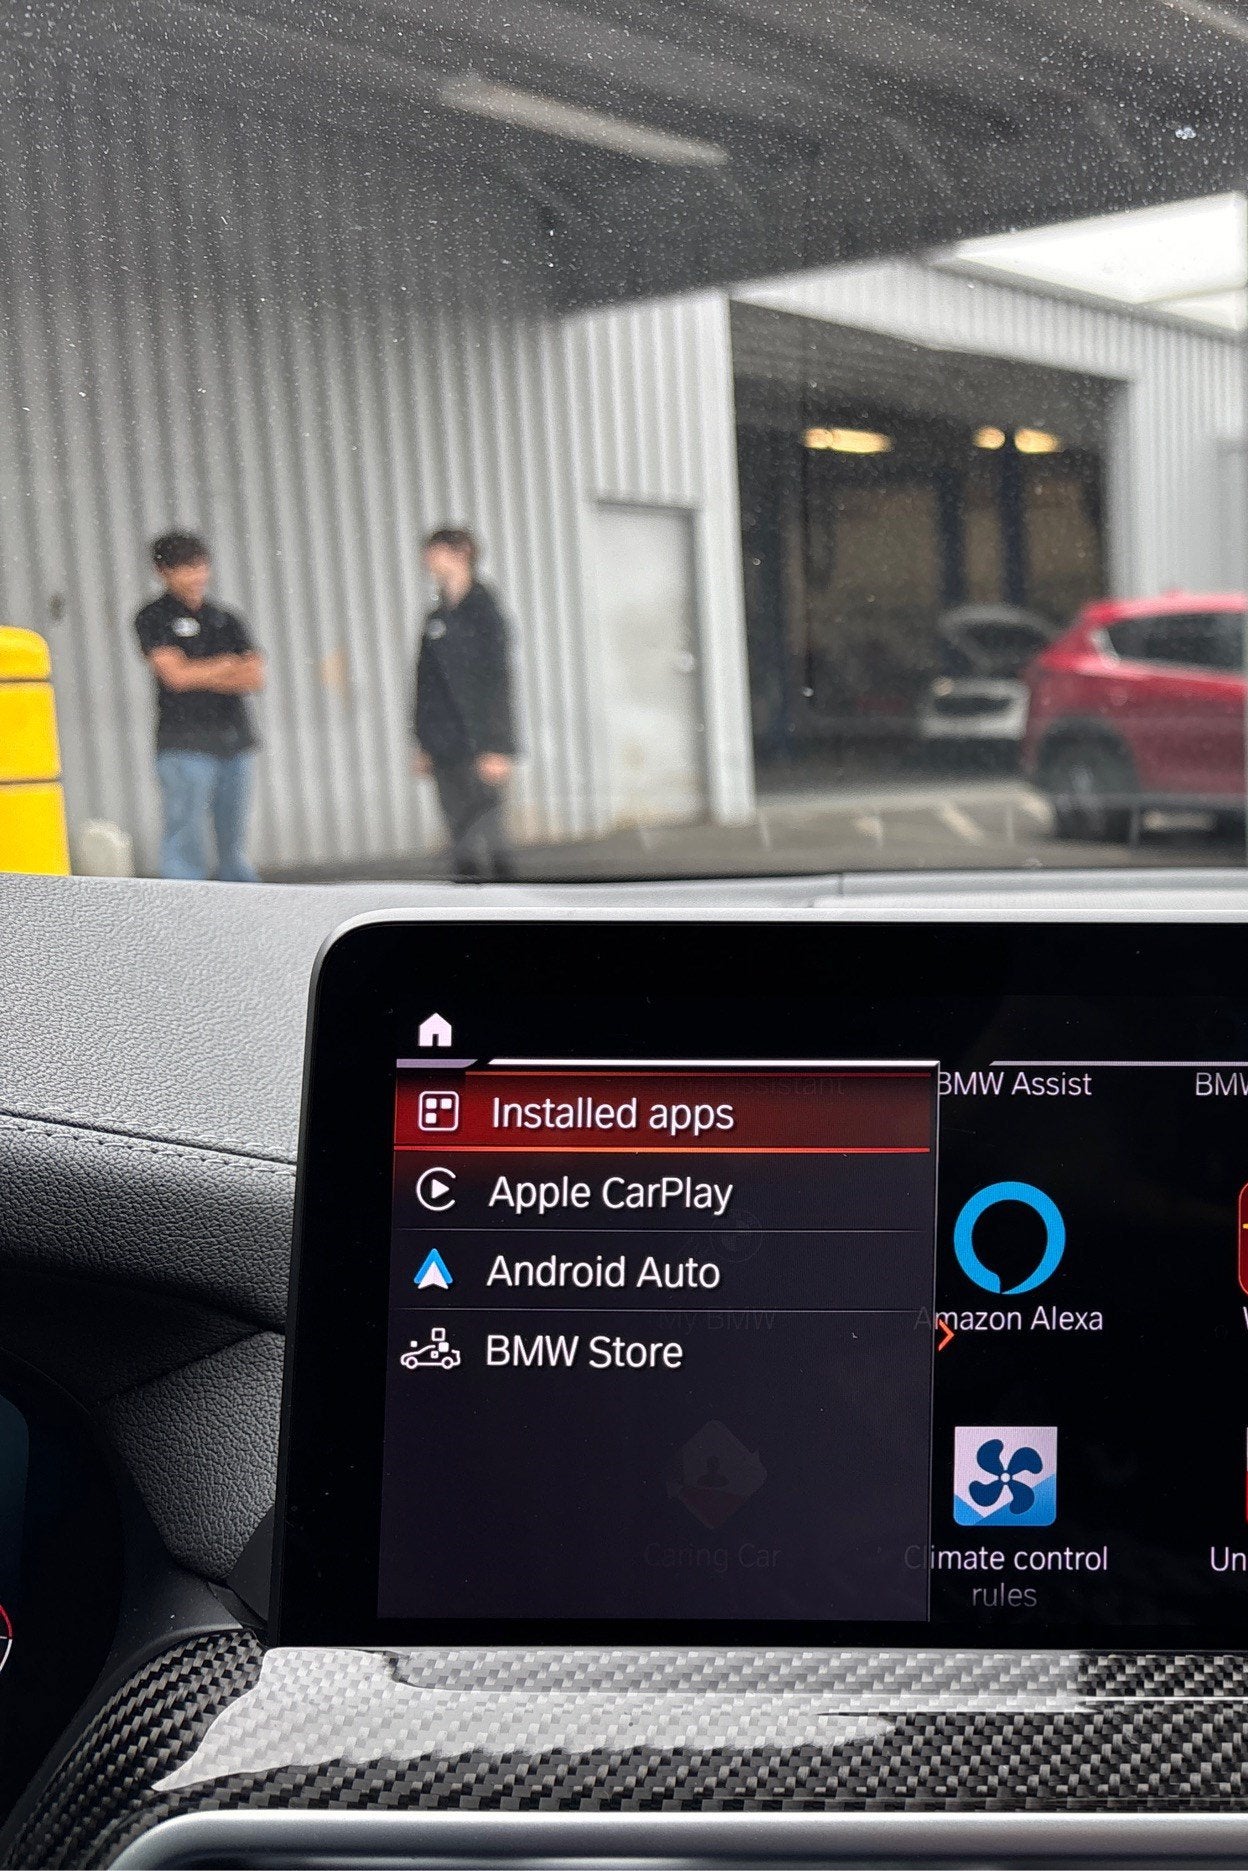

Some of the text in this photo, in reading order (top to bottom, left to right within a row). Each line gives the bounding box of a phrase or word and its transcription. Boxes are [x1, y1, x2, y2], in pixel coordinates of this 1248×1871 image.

[937, 1070, 1093, 1097] BMW Assist
[491, 1095, 735, 1137] Installed apps
[488, 1174, 735, 1217] Apple CarPlay
[485, 1254, 722, 1290] Android Auto
[914, 1305, 1104, 1332] Amazon Alexa
[485, 1334, 684, 1370] BMW Store
[904, 1544, 1109, 1572] Climate control
[971, 1581, 1038, 1608] rules
